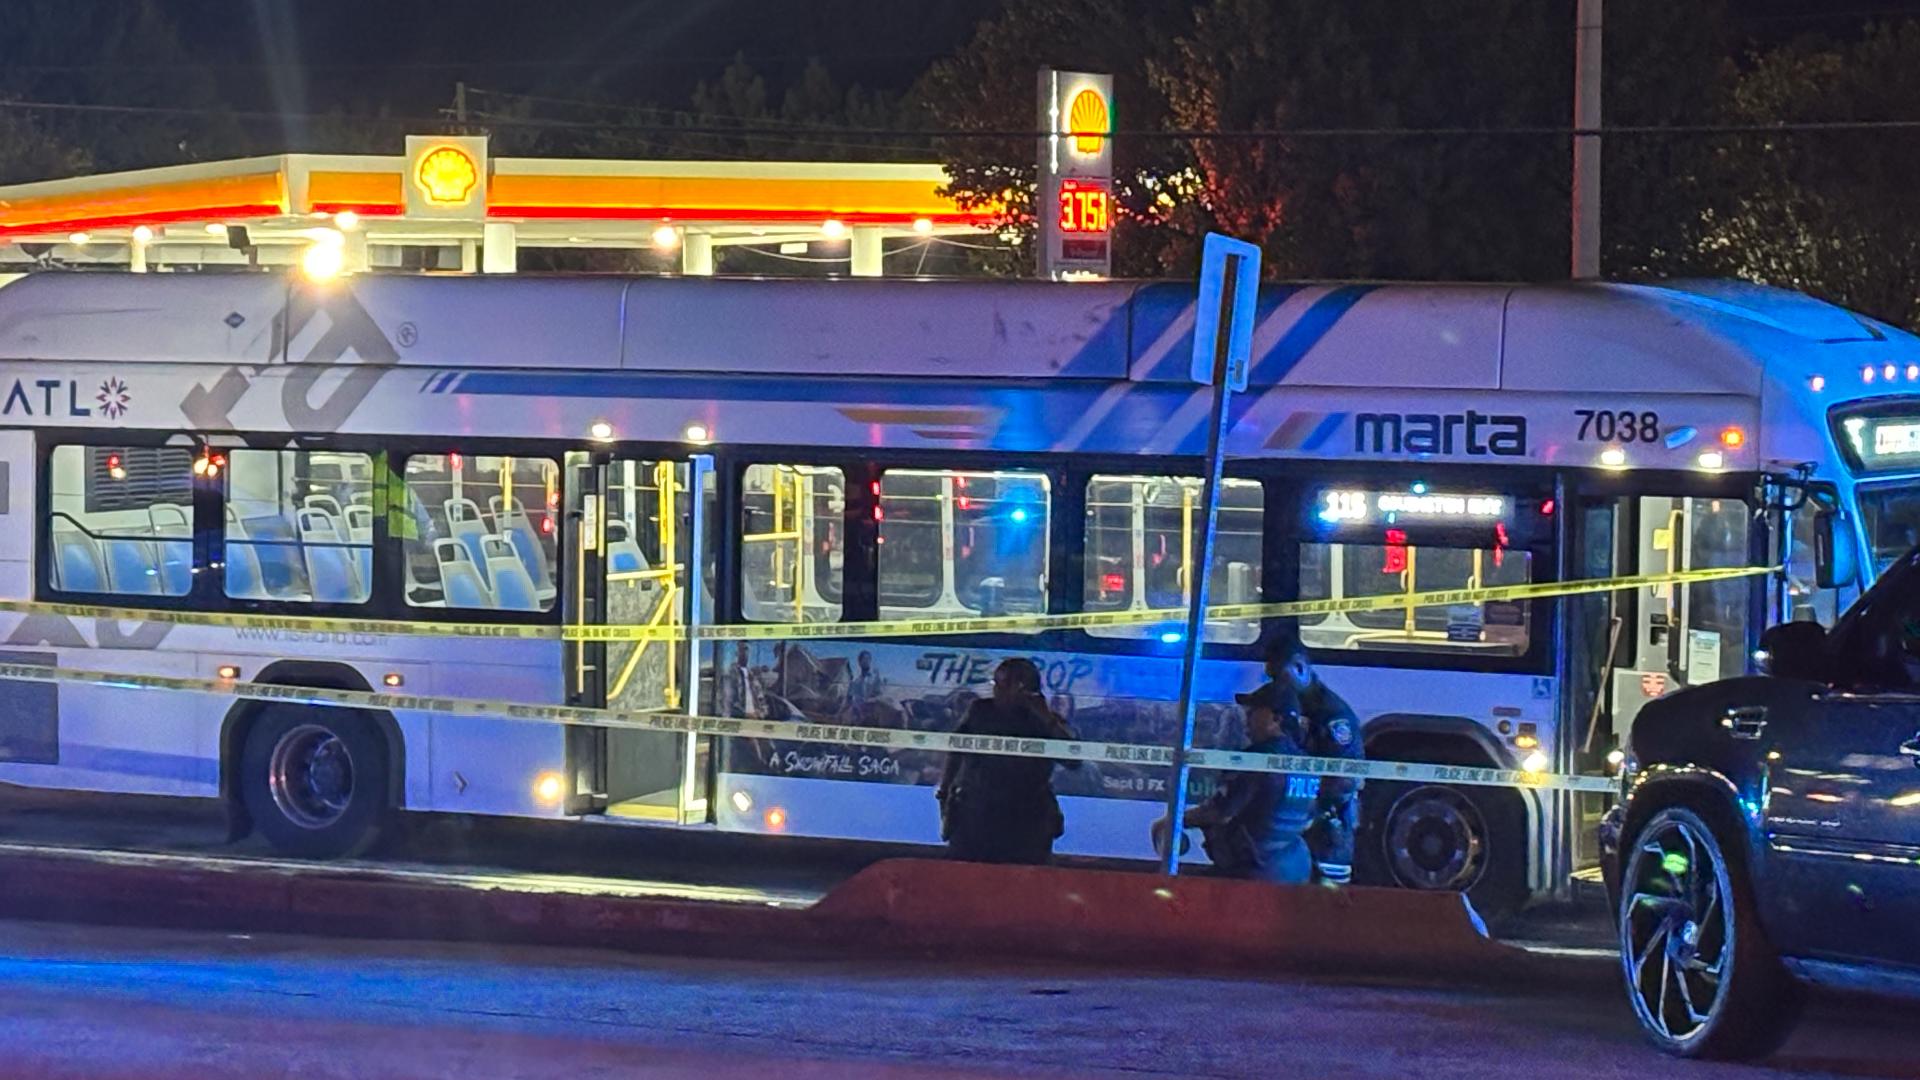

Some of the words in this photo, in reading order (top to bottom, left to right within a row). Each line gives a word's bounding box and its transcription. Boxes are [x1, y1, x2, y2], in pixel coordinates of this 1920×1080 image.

[2, 379, 91, 417] ATL
[1355, 410, 1527, 456] marta
[1573, 409, 1660, 443] 7038
[923, 652, 994, 685] THE
[769, 751, 780, 769] A
[858, 755, 899, 776] SAGA
[1103, 775, 1133, 792] Sept
[1148, 778, 1165, 791] FX
[1287, 776, 1321, 799] POLICE
